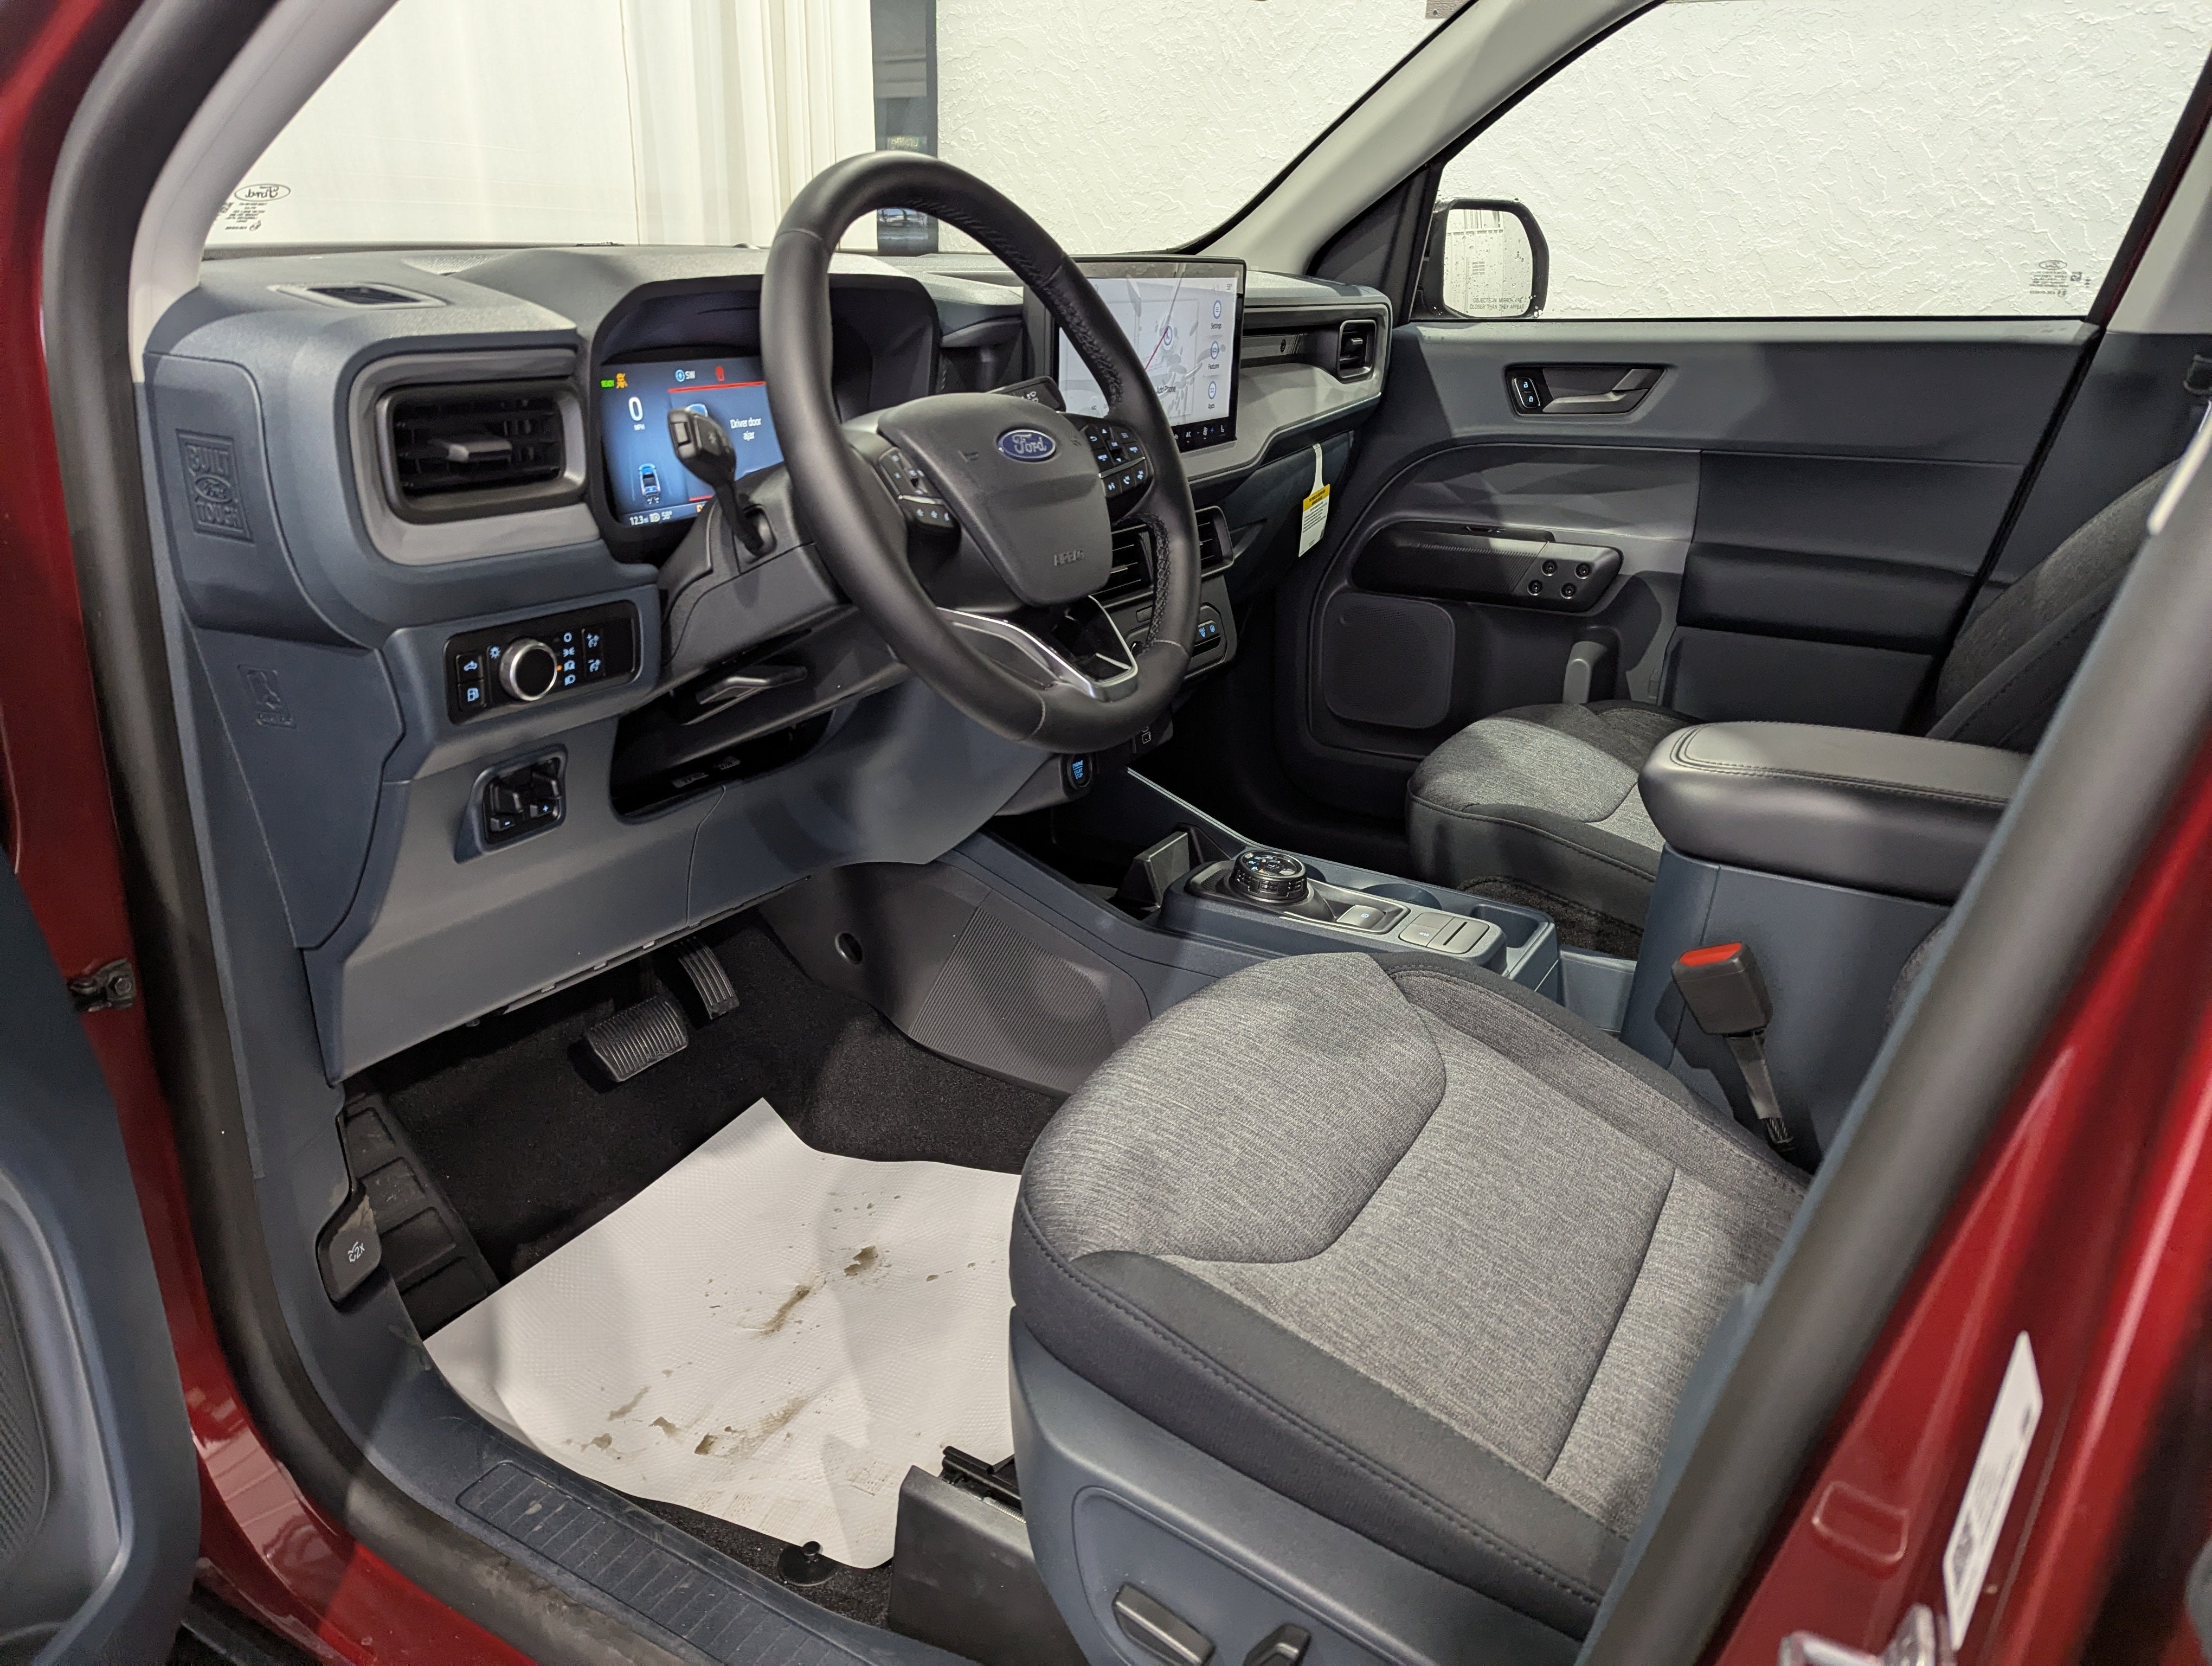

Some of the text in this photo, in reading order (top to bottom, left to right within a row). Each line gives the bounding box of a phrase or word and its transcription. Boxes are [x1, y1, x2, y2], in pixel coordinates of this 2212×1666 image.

[628, 396, 644, 421] 0
[730, 417, 761, 428] Driver door
[743, 431, 755, 441] ajar
[1012, 433, 1047, 454] Ford
[187, 444, 229, 476] BUILT
[195, 501, 244, 530] TOUGH
